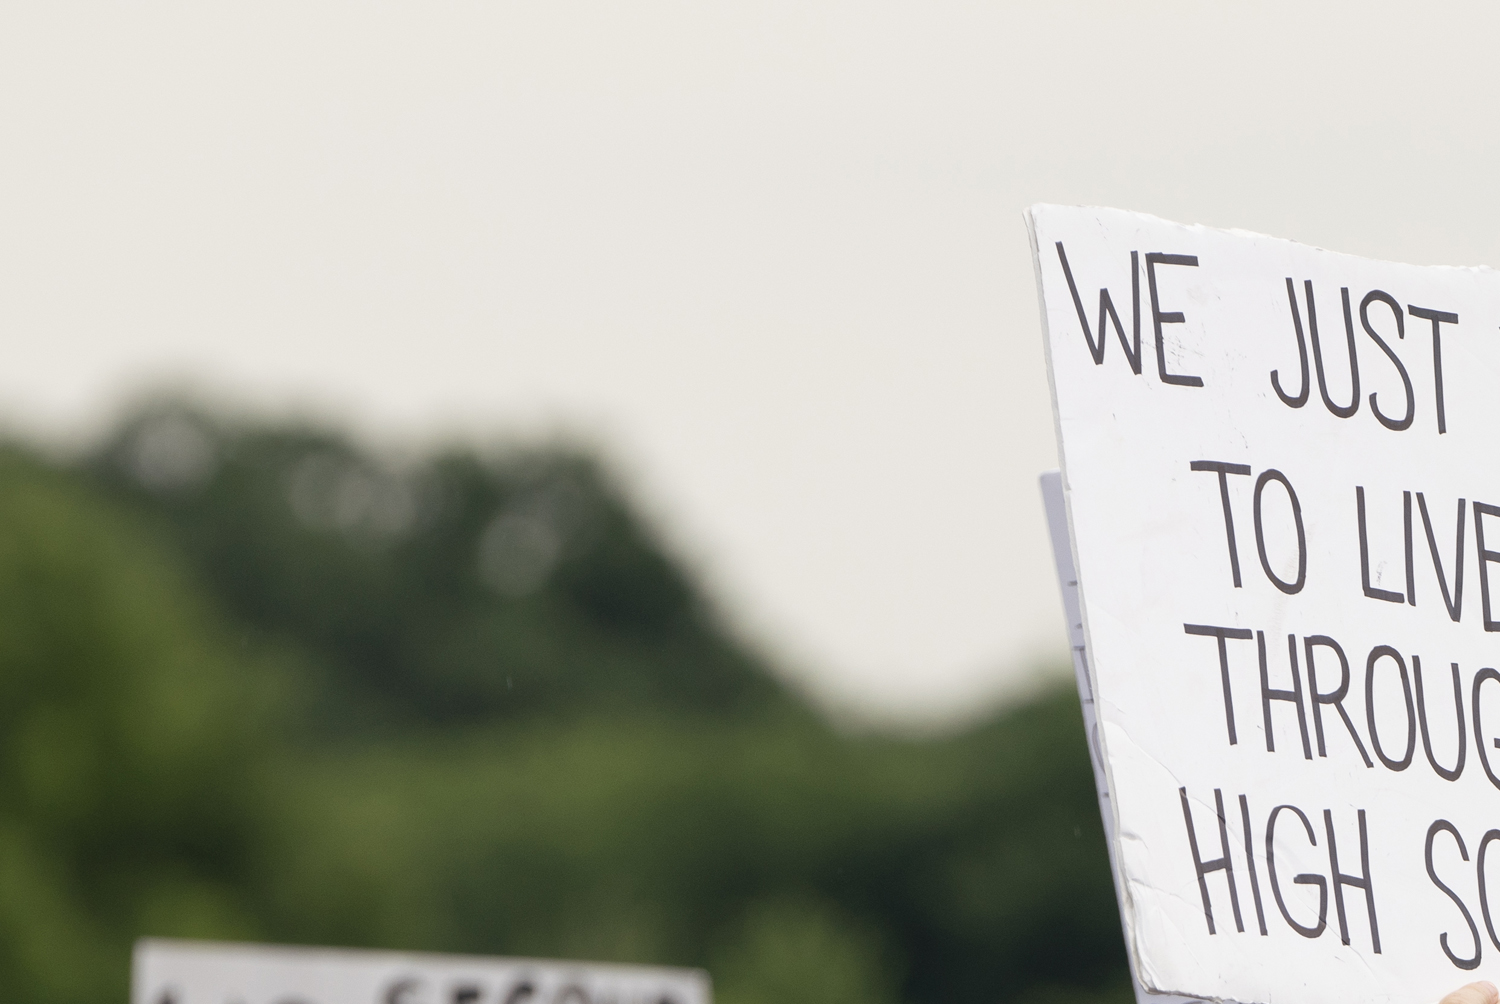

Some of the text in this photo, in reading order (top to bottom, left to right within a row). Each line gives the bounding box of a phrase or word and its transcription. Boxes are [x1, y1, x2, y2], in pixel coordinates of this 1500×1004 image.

[1055, 241, 1204, 388] WE
[1270, 277, 1459, 435] JUST
[1190, 460, 1308, 596] TO
[1179, 786, 1382, 955] HIGH
